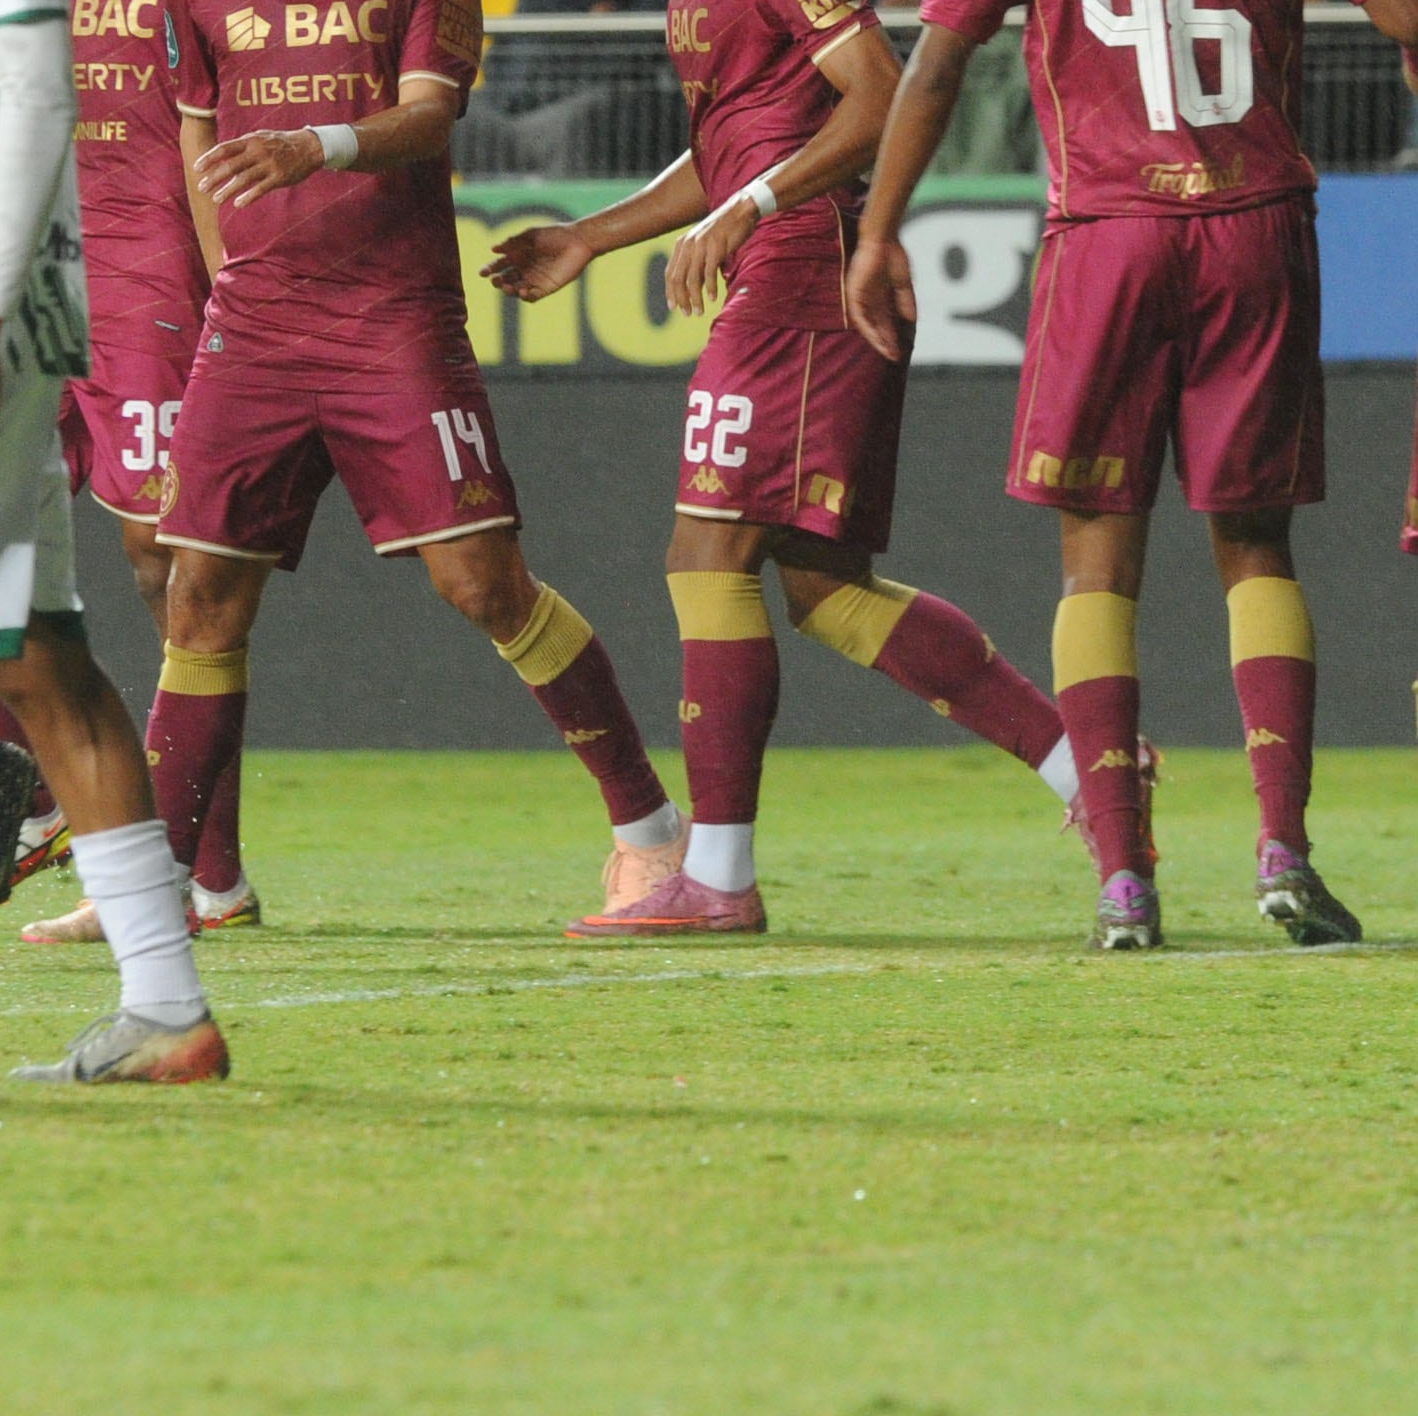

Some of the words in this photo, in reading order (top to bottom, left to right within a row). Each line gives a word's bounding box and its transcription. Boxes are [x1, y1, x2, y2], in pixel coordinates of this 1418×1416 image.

[671, 8, 712, 53] BAC
[72, 63, 156, 91] ERTY
[236, 72, 384, 107] LIBERTY
[72, 120, 128, 142] NILIFE
[430, 407, 492, 482] 14
[684, 389, 754, 468] 22
